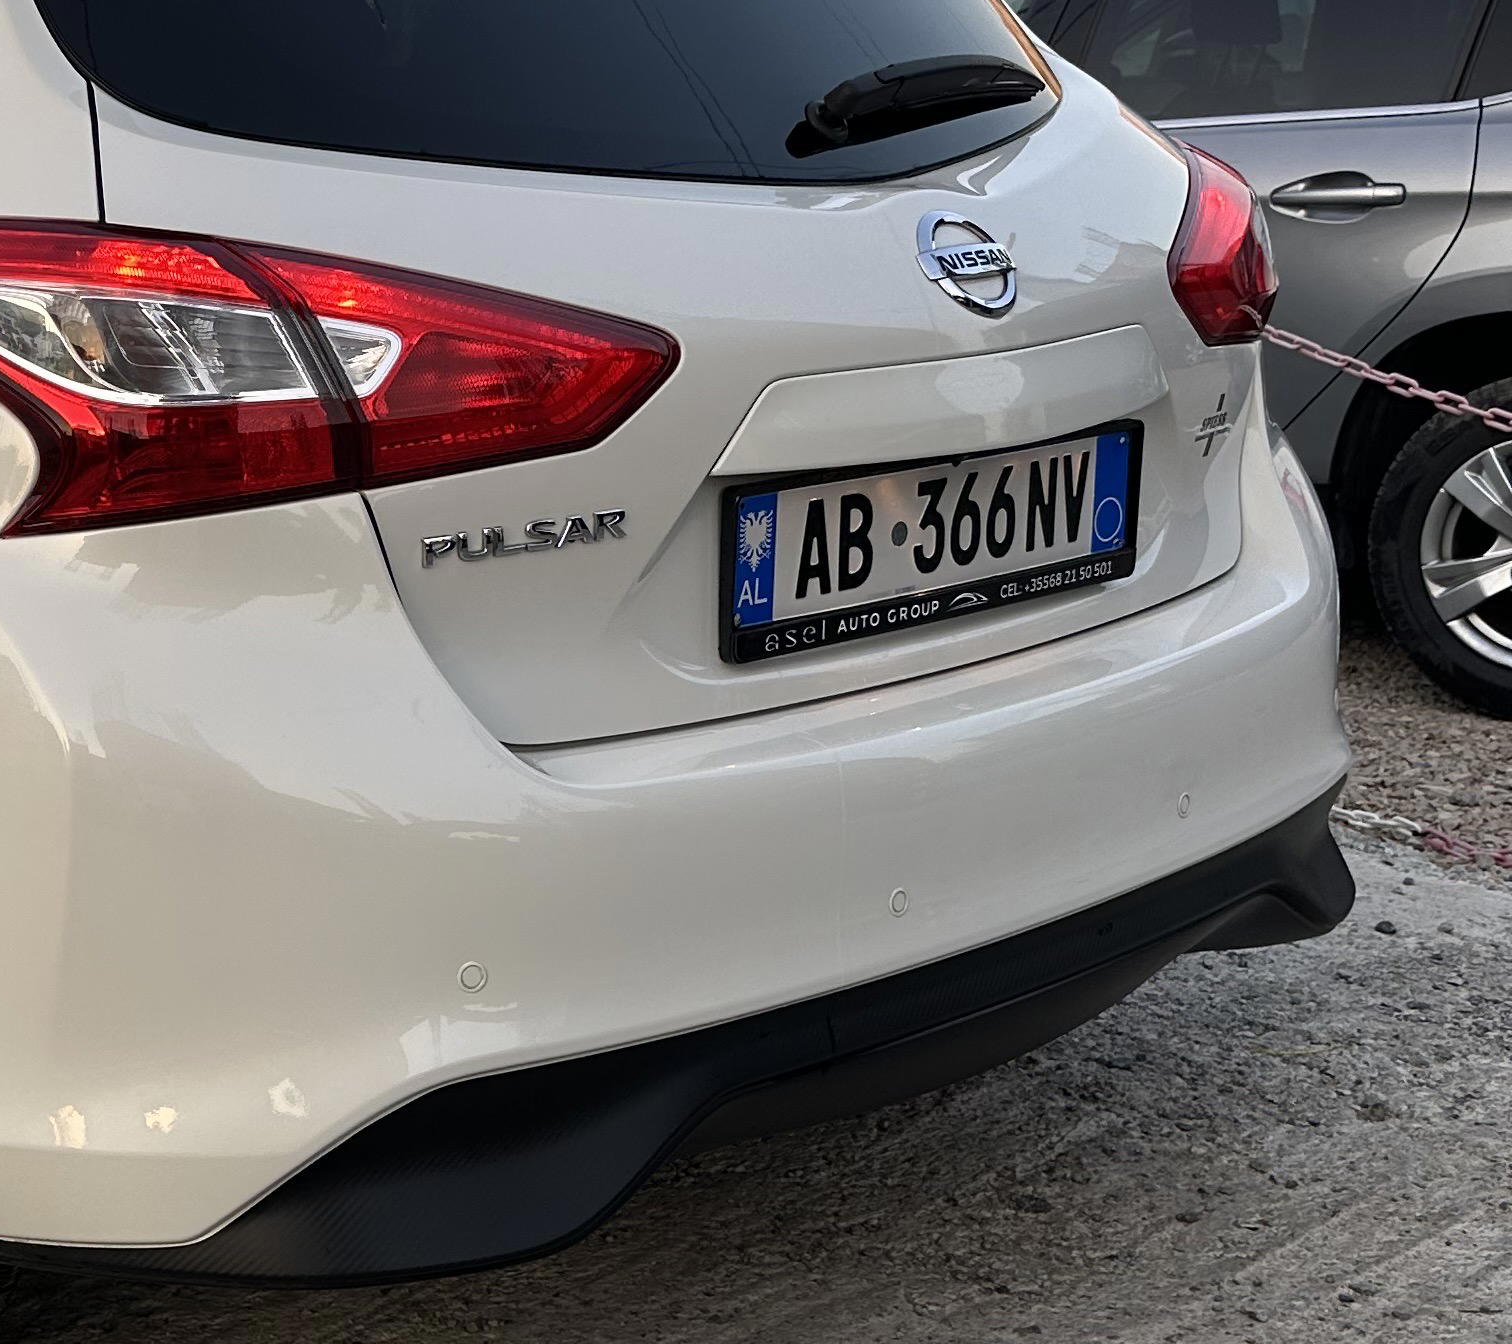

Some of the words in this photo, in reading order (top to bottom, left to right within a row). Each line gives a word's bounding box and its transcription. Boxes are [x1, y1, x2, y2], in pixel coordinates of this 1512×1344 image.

[938, 247, 1014, 272] NISSAN
[420, 508, 628, 569] PULSAR
[794, 491, 874, 600] AB
[736, 577, 768, 609] AL
[837, 612, 881, 635] AUTO
[887, 600, 940, 624] GROUP
[1024, 572, 1063, 593] +35568
[1064, 569, 1077, 585] 21
[1079, 565, 1092, 581] 50
[1093, 560, 1113, 576] 501
